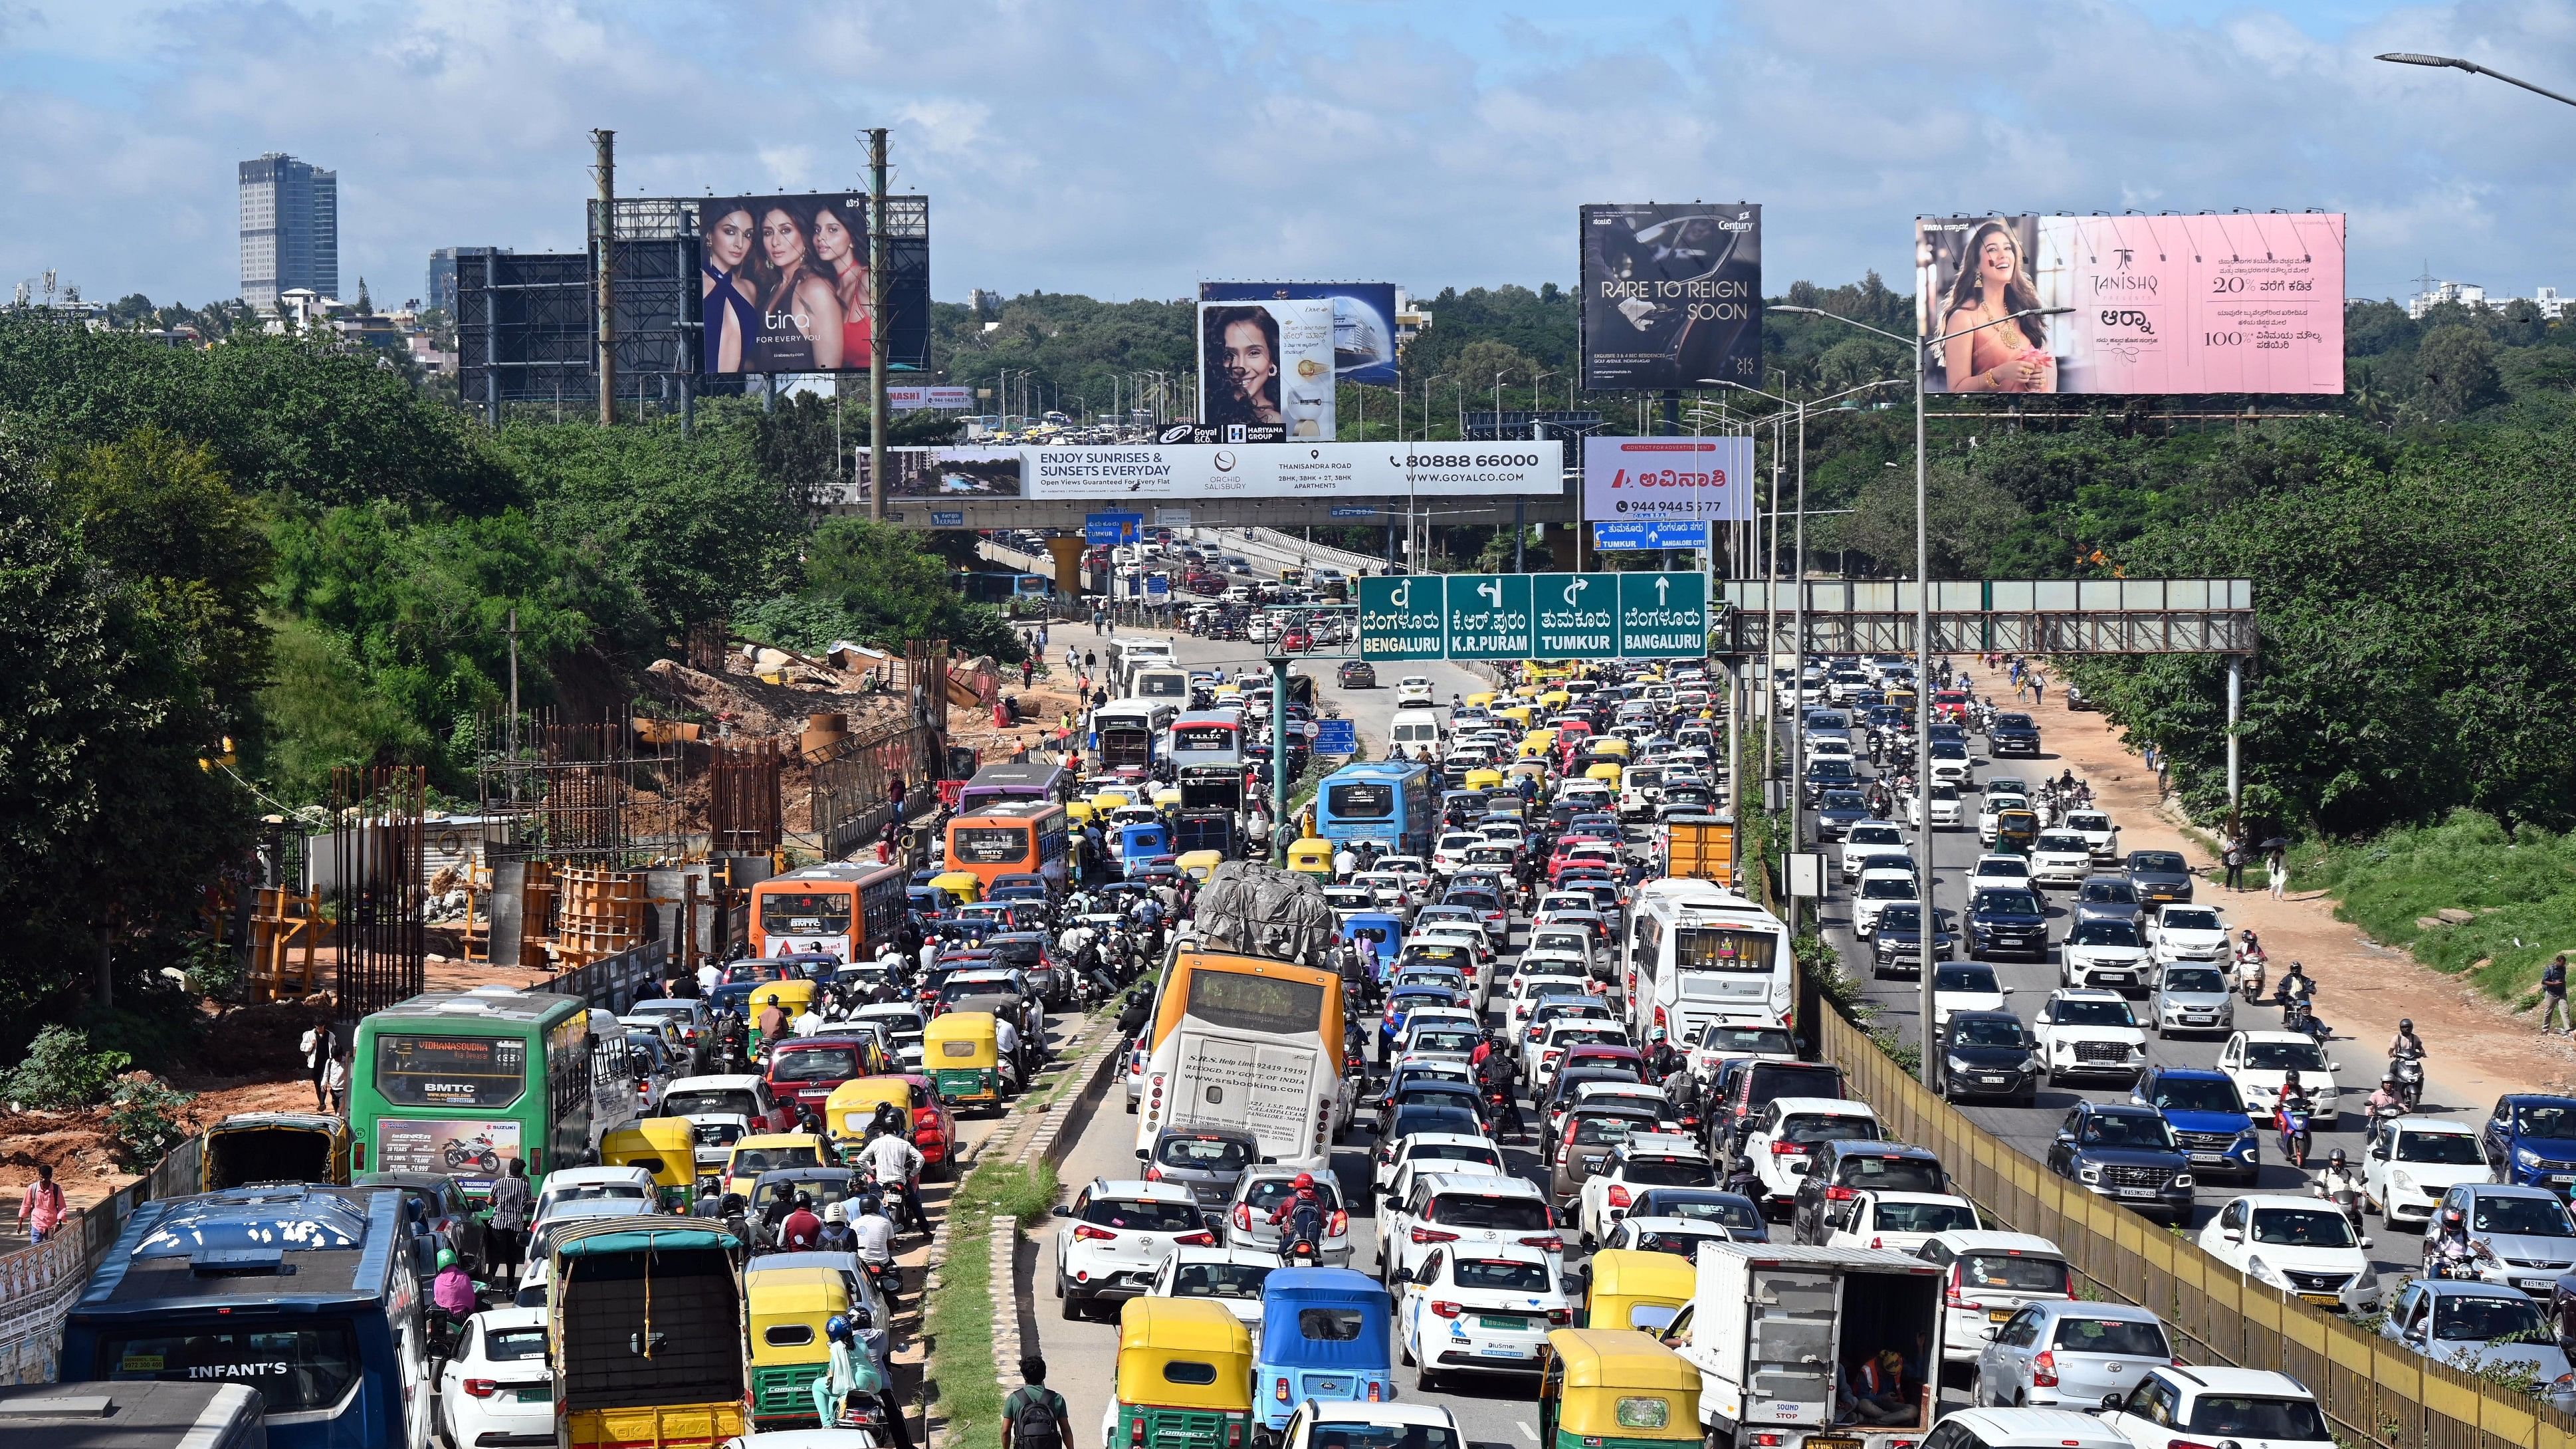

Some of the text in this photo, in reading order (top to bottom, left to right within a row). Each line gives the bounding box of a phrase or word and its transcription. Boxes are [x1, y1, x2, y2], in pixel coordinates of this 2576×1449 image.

[1719, 220, 1753, 231] Century
[1601, 280, 1748, 298] RARE TO REIGN
[2090, 271, 2158, 296] TANISHQ
[2212, 277, 2256, 293] 20%
[1687, 302, 1748, 320] SOON
[765, 310, 809, 330] tira
[1194, 428, 1217, 437] Goyal
[1041, 453, 1162, 463] ENJOY SUNRISES &
[1406, 454, 1539, 468] 80888 66000
[1041, 465, 1170, 476] SUNSETS EVERYDAY
[1406, 473, 1524, 483] WWW.GOYALCO.COM
[1639, 469, 1726, 487] ಅವಿನಾಶಿ
[1631, 501, 1656, 512] 944
[1659, 501, 1682, 512] 944
[1705, 501, 1721, 511] 77
[1608, 523, 1644, 532] ತುಮಕೂರು
[1690, 522, 1703, 531] ನಗರ
[1362, 610, 1440, 630] ಬೆಂಗಳೂರು
[1541, 608, 1611, 628] ತುಮಕೂರು
[1625, 607, 1700, 627] ಬೆಂಗಳೂರು
[1363, 633, 1701, 653] BENGALURU K.R.PURAM TUMKUR BANGALURU
[419, 1042, 488, 1052] VIDHANASOUDHA
[1186, 1064, 1223, 1074] RECOGD.
[1257, 1062, 1281, 1071] 92419
[1283, 1066, 1307, 1075] 19191
[424, 1083, 475, 1092] BMTC
[1185, 1074, 1304, 1094] www.srsbooking.com
[189, 1362, 287, 1379] INFANT'S
[1158, 1428, 1204, 1438] Compact
